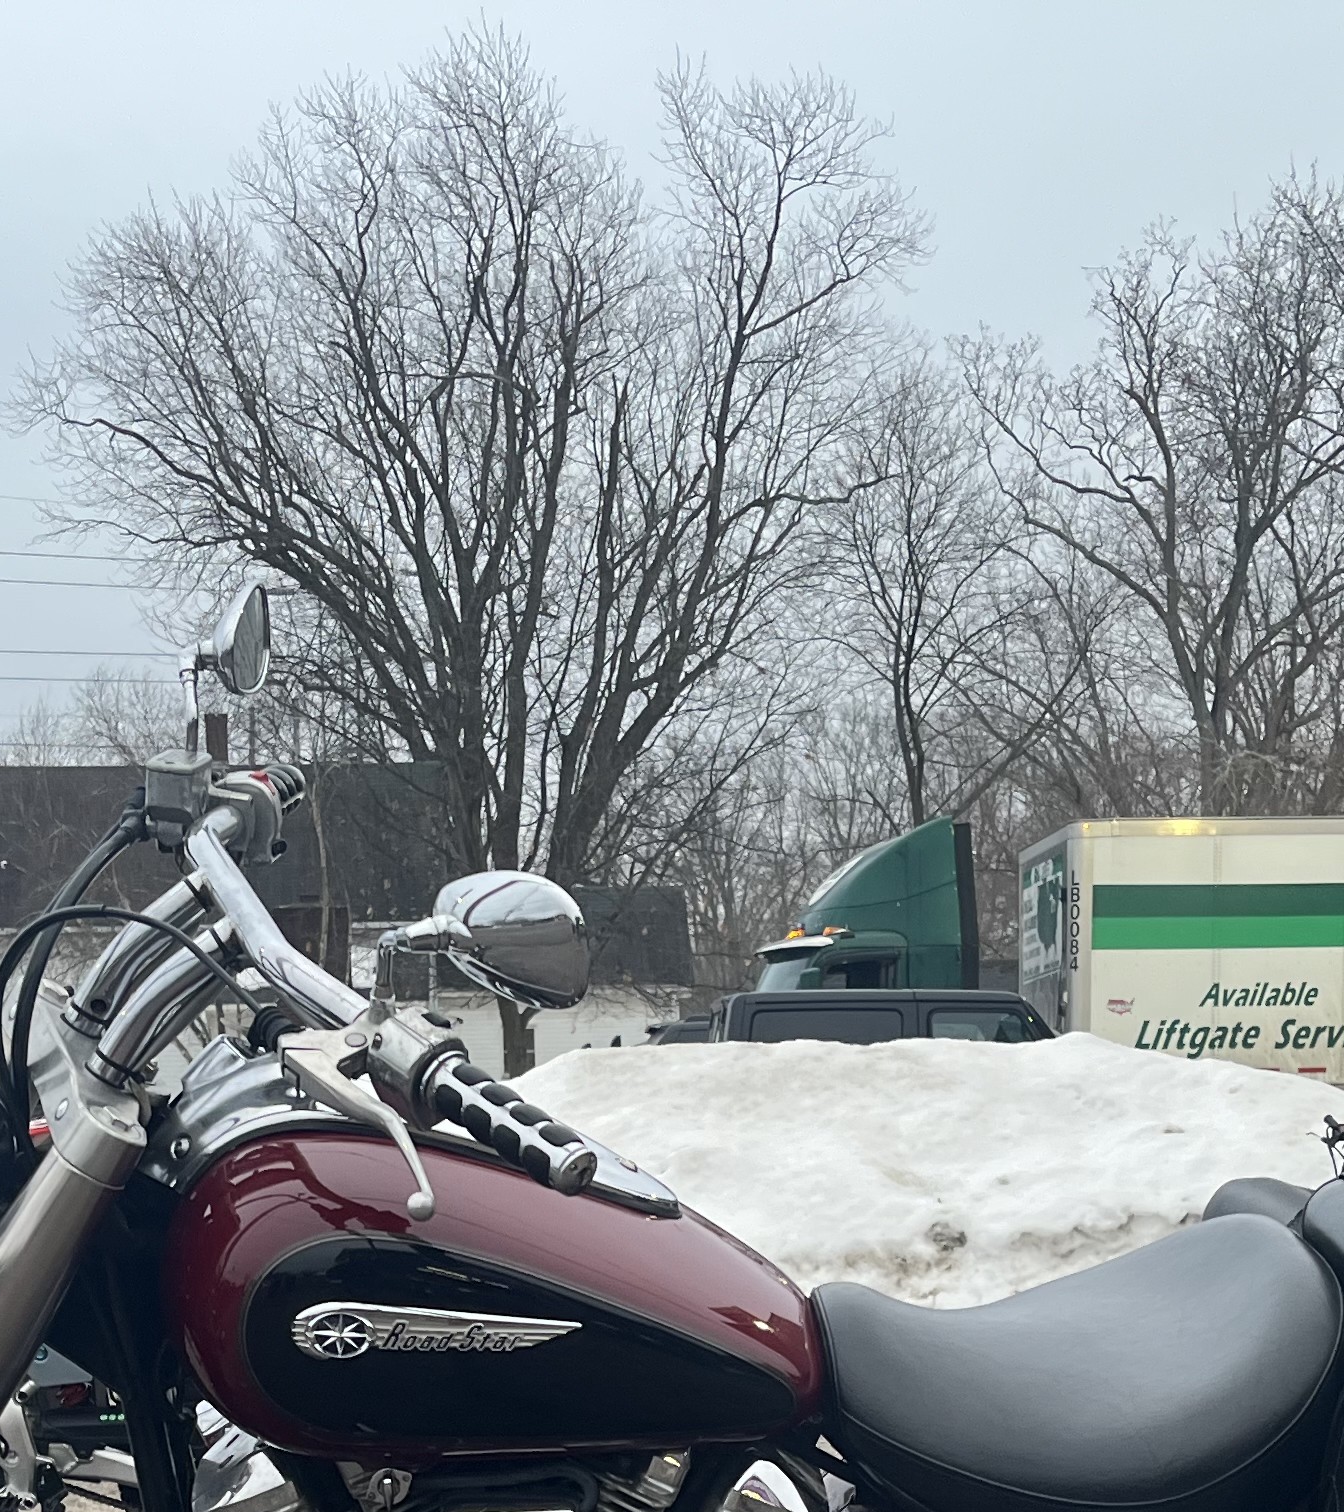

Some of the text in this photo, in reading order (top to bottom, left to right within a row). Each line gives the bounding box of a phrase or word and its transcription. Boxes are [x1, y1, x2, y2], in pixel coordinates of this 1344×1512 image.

[1069, 870, 1080, 972] LB0084
[1199, 982, 1319, 1008] Available
[1134, 1018, 1261, 1059] Liftgate
[380, 1319, 524, 1352] Road Star
